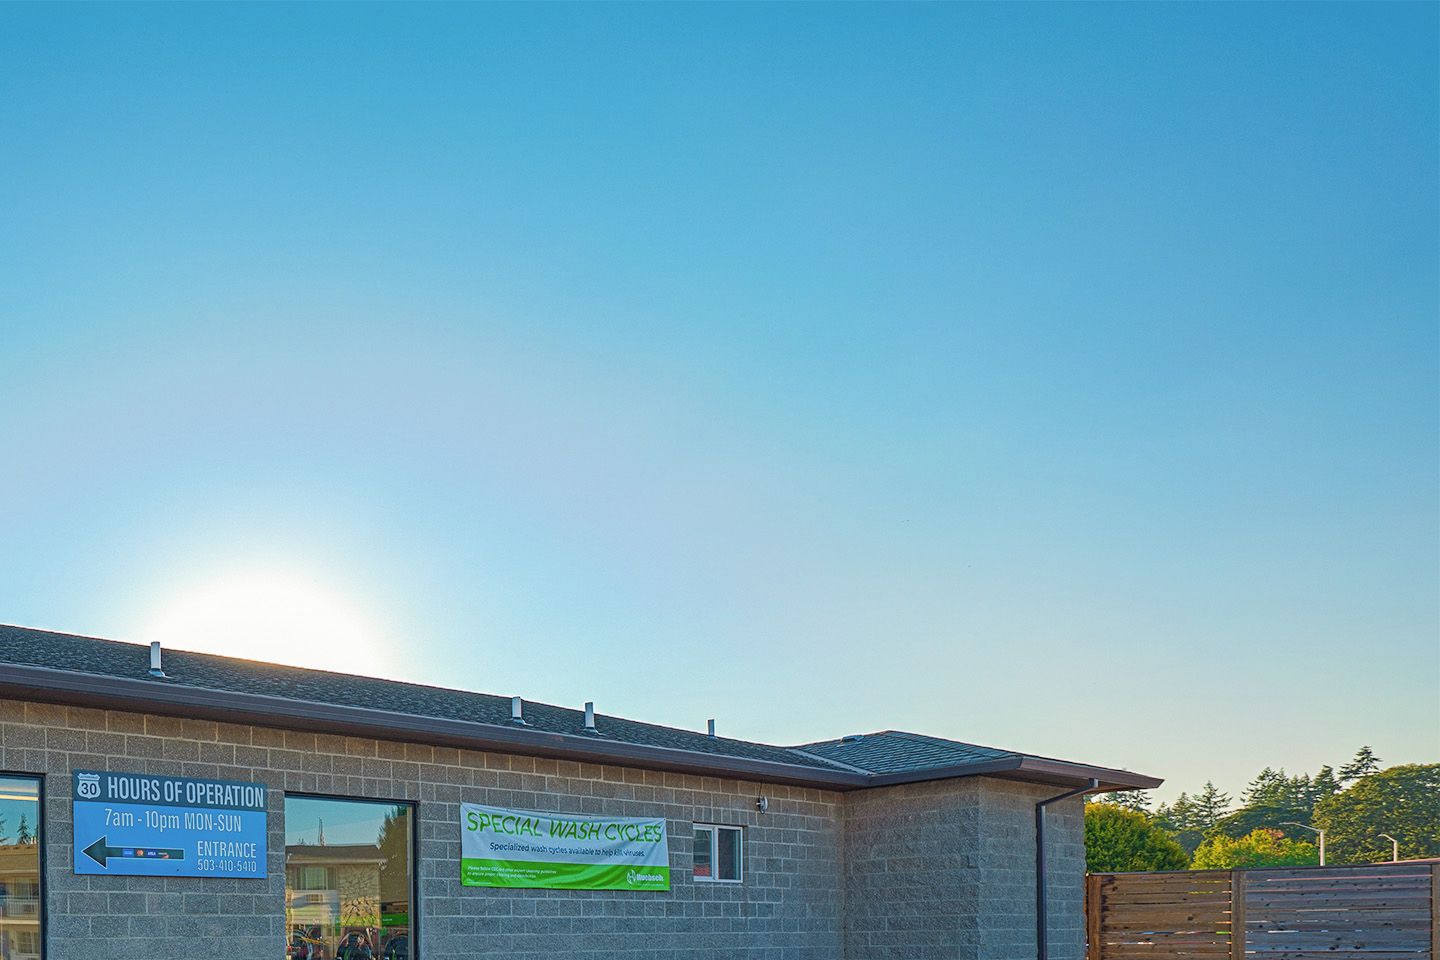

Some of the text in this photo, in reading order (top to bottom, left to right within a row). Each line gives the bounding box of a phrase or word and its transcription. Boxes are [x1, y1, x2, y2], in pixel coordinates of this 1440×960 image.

[81, 782, 97, 795] 30
[108, 776, 264, 808] HOURS OF OPERATION
[104, 808, 134, 827] 7am
[145, 811, 179, 832] 10pm
[184, 812, 242, 832] MON-SUN
[466, 811, 662, 843] SPECIAL WASH CYCLES
[197, 840, 257, 859] ENTRANCE
[489, 842, 530, 852] Specialized
[549, 846, 568, 855] cycles
[568, 847, 594, 856] available
